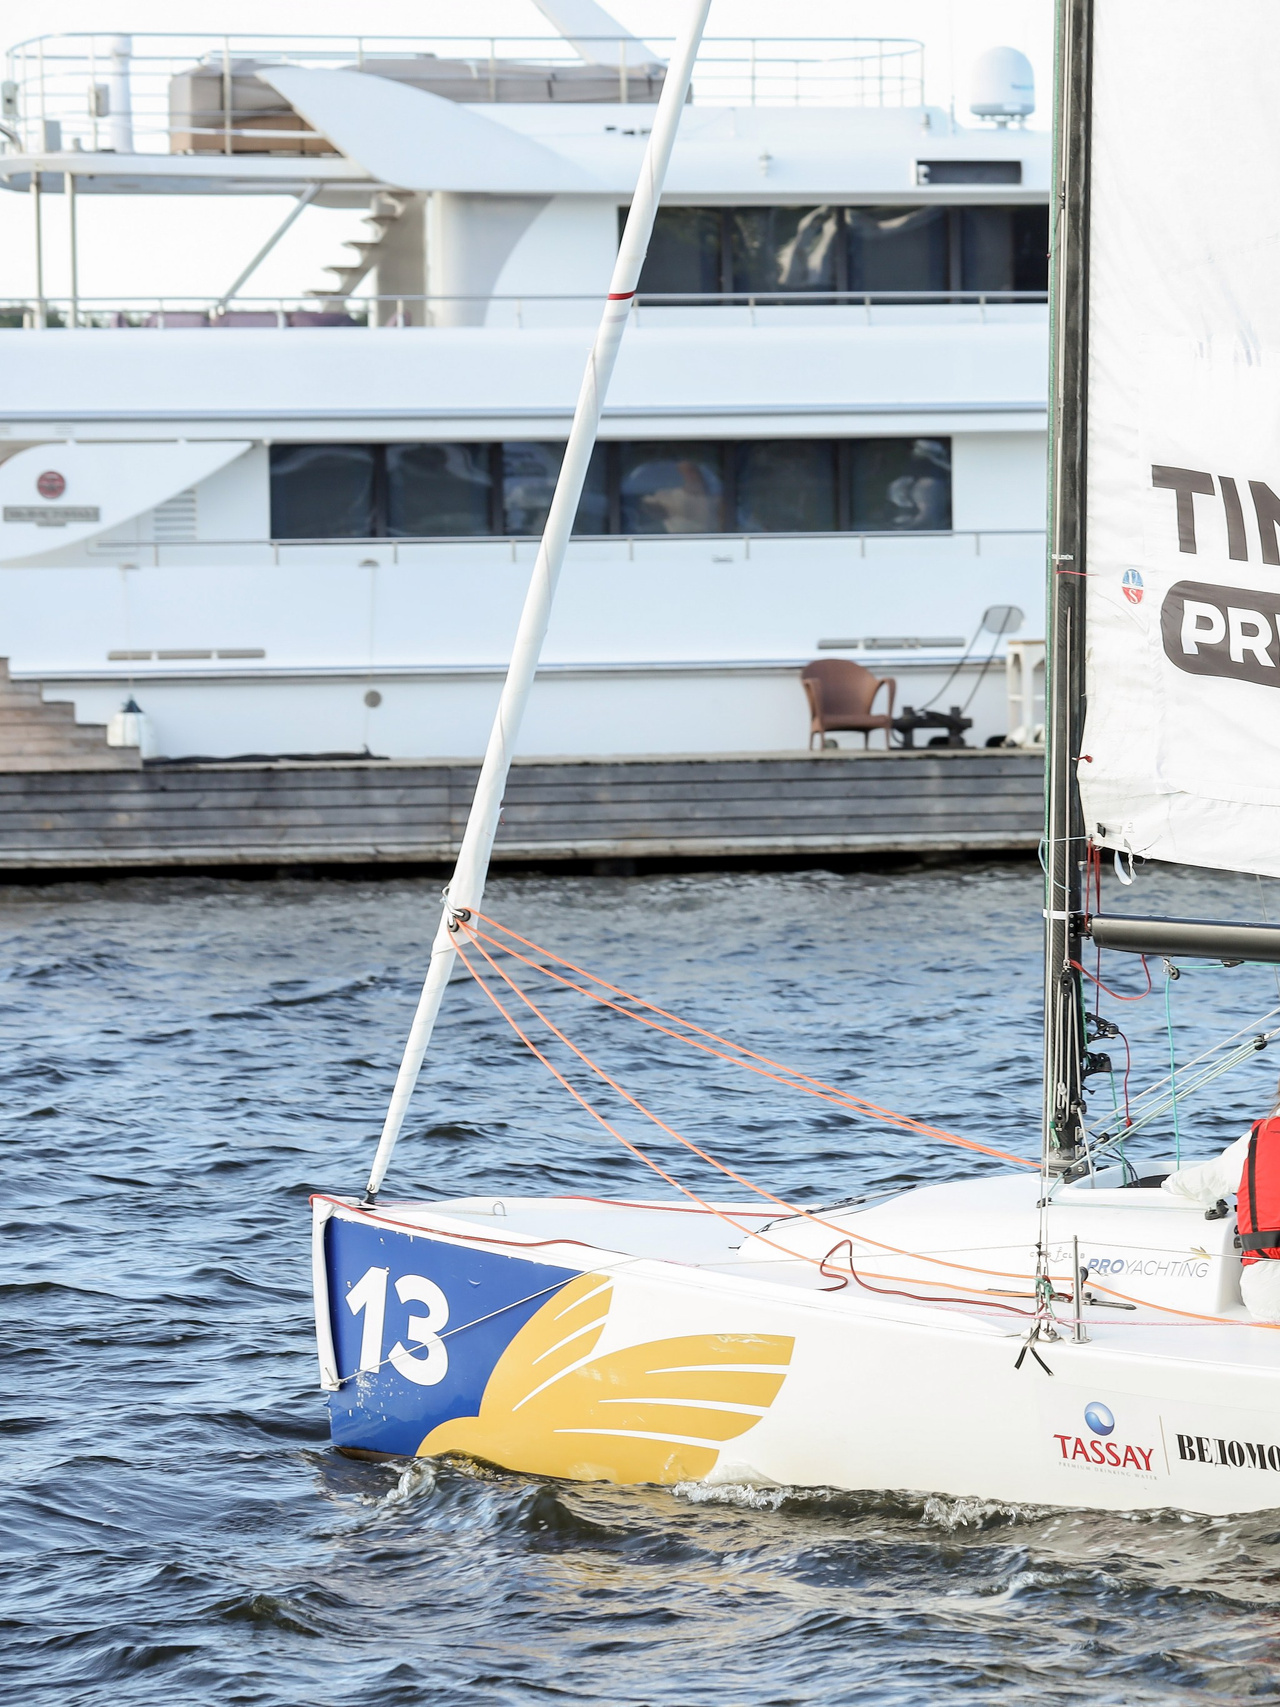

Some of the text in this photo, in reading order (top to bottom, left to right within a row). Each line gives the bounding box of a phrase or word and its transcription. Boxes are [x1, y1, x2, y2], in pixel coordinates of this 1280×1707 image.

[1086, 1258, 1210, 1278] PROYACHTING
[345, 1266, 450, 1387] 13
[1053, 1434, 1154, 1471] TASSAY
